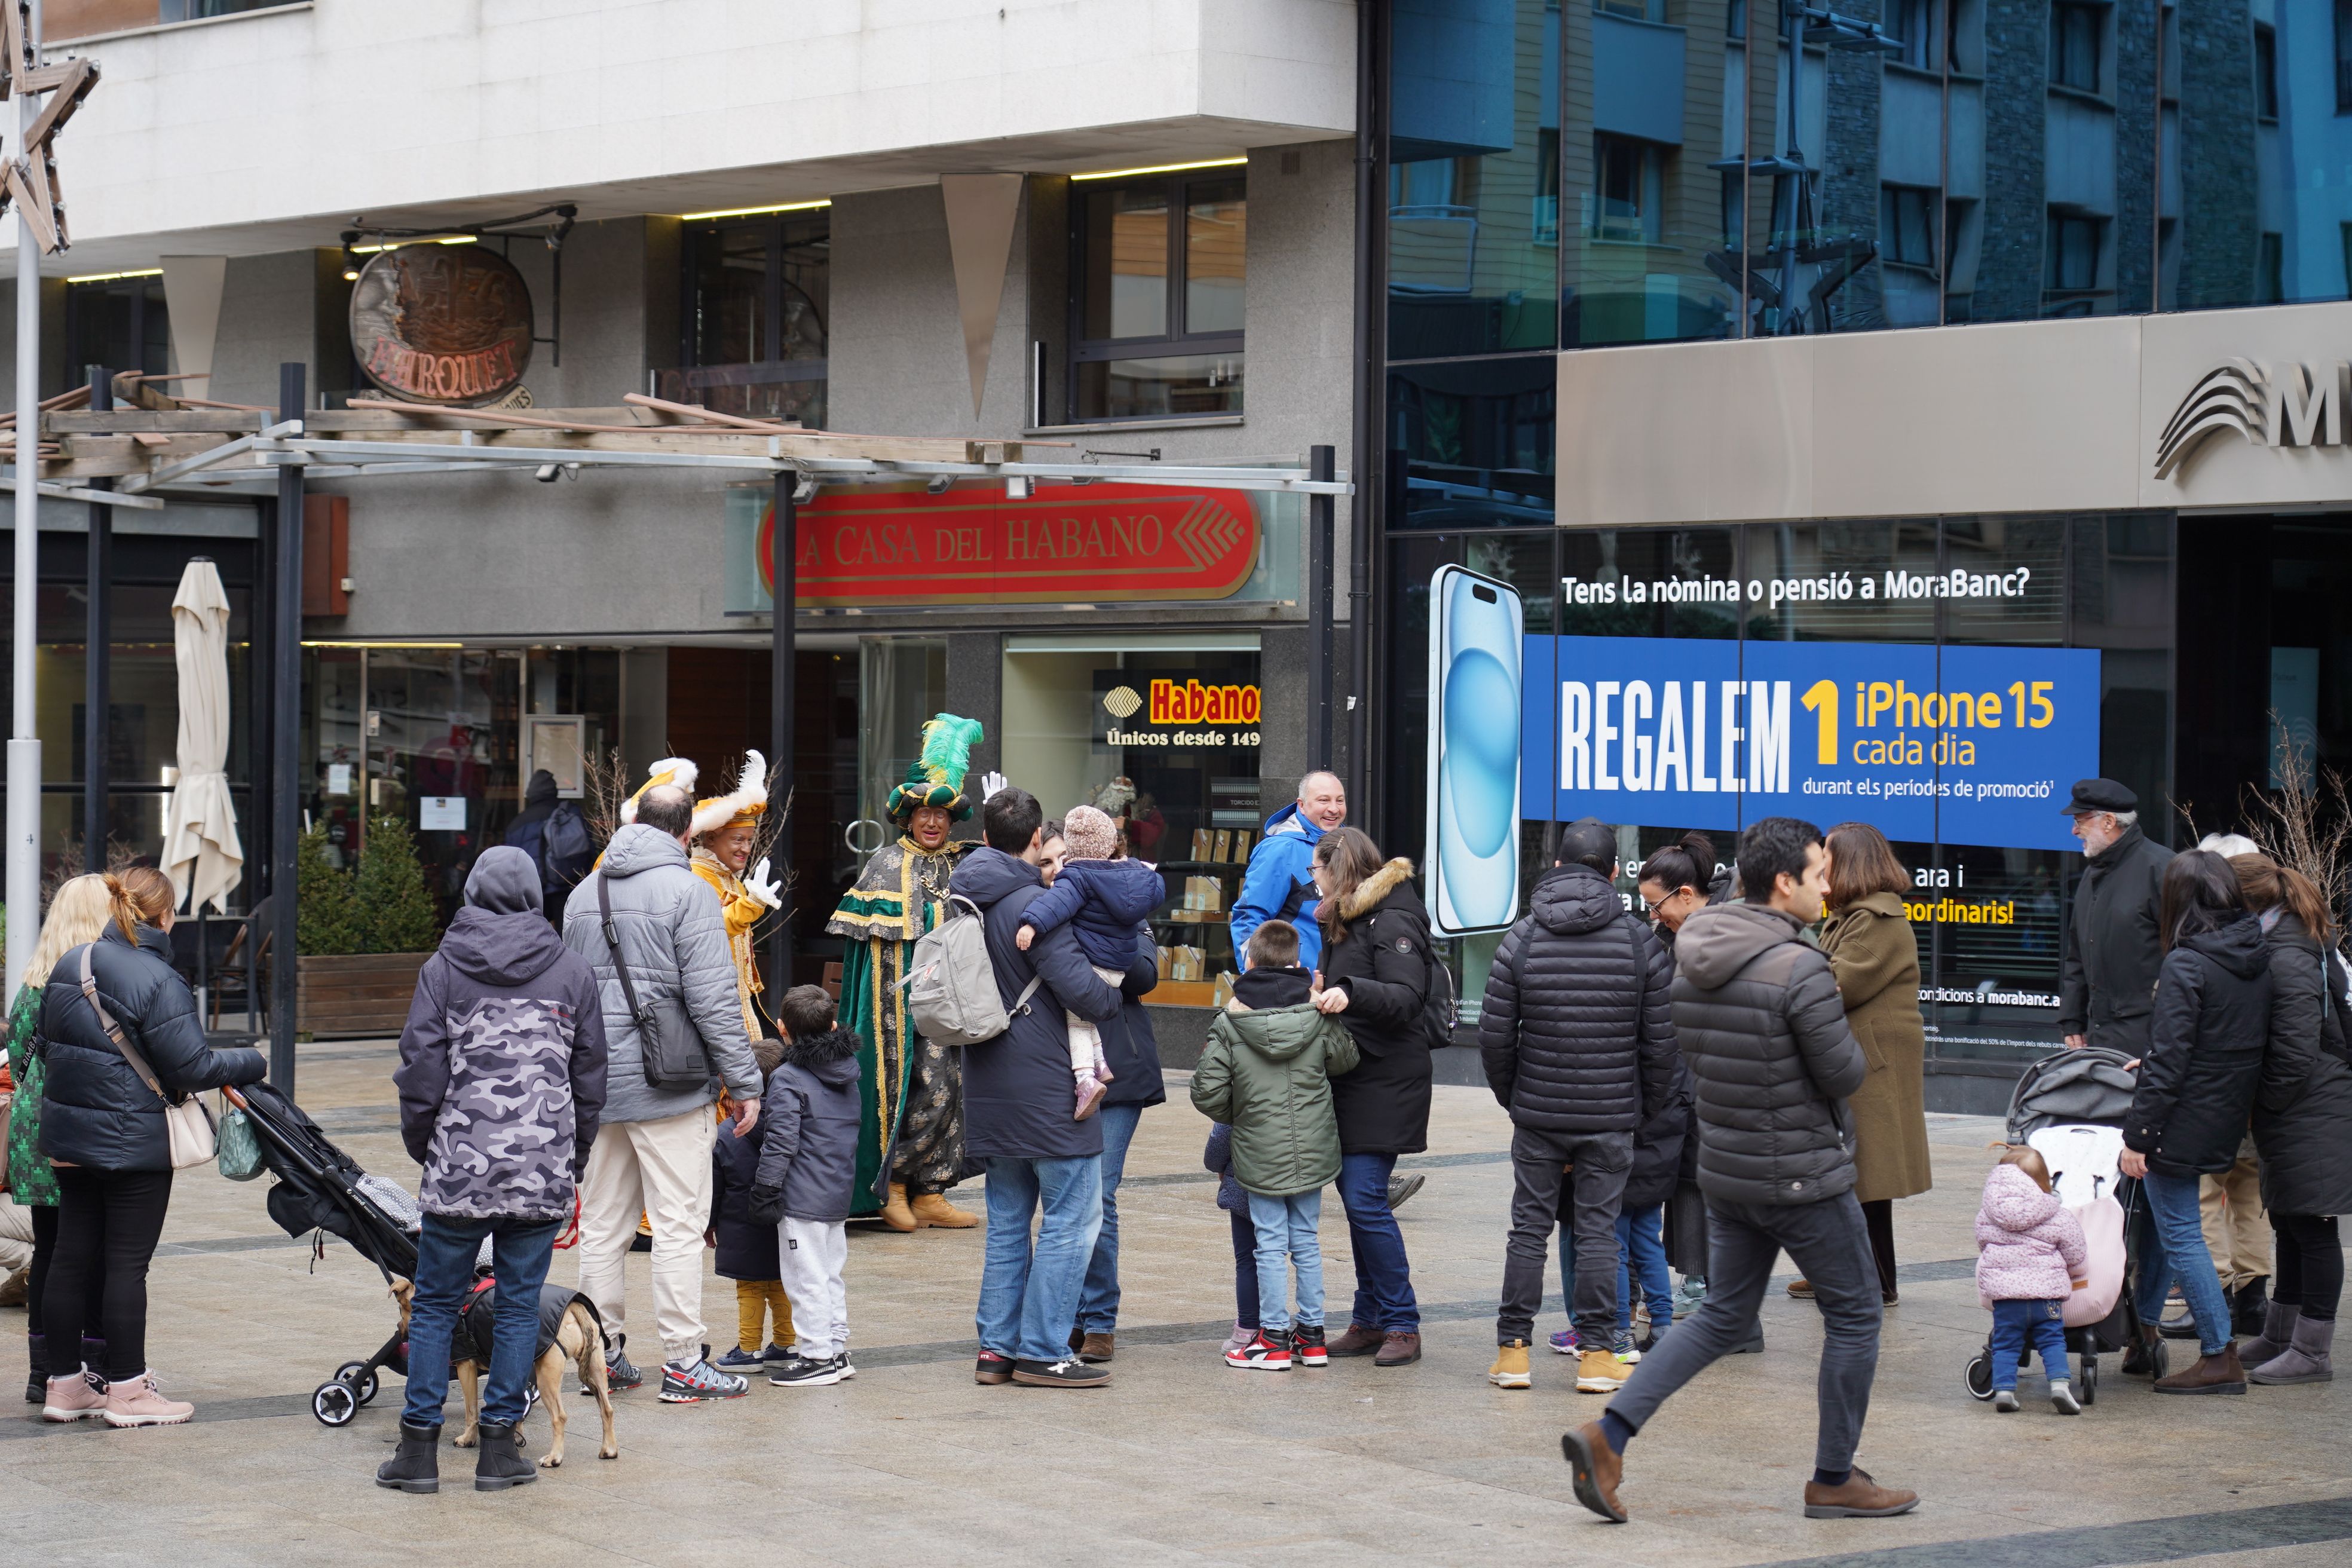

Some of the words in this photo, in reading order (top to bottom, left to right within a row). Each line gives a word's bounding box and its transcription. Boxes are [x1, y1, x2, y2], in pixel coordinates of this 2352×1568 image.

[368, 335, 517, 397] MARQUET
[2268, 360, 2344, 447] M
[795, 534, 822, 565] A
[835, 524, 921, 565] CASA
[935, 528, 992, 562] DEL
[1006, 514, 1163, 559] HABANO
[1562, 576, 1616, 604] Tens
[1623, 575, 1646, 604] la
[1653, 574, 1740, 602] nòmina
[1748, 580, 1762, 601] o
[1769, 571, 1852, 609] pensió
[1861, 577, 1873, 599] a
[1885, 566, 2030, 599] MoraBanc?
[1150, 679, 1261, 724] Habano
[1856, 679, 2002, 728] iPhone
[2008, 681, 2054, 728] 15
[1107, 727, 1168, 746] Únicos
[1173, 731, 1226, 746] desde
[1232, 732, 1261, 746] 149
[1561, 679, 1790, 794] REGALEM
[1801, 679, 1839, 765] 1
[1854, 733, 1922, 765] cada
[1933, 731, 1975, 765] dia
[1803, 777, 1852, 795] durant
[1857, 778, 1880, 795] els
[1884, 778, 1950, 800] períodes
[1953, 779, 1973, 797] de
[1915, 868, 1949, 887] ara
[1958, 864, 1963, 887] i
[1902, 898, 2014, 924] aordinaris!
[1977, 992, 1984, 1003] a
[1988, 990, 2060, 1007] morabanc.a
[22, 1036, 37, 1067] BIMBA
[665, 1377, 685, 1388] SALOMON
